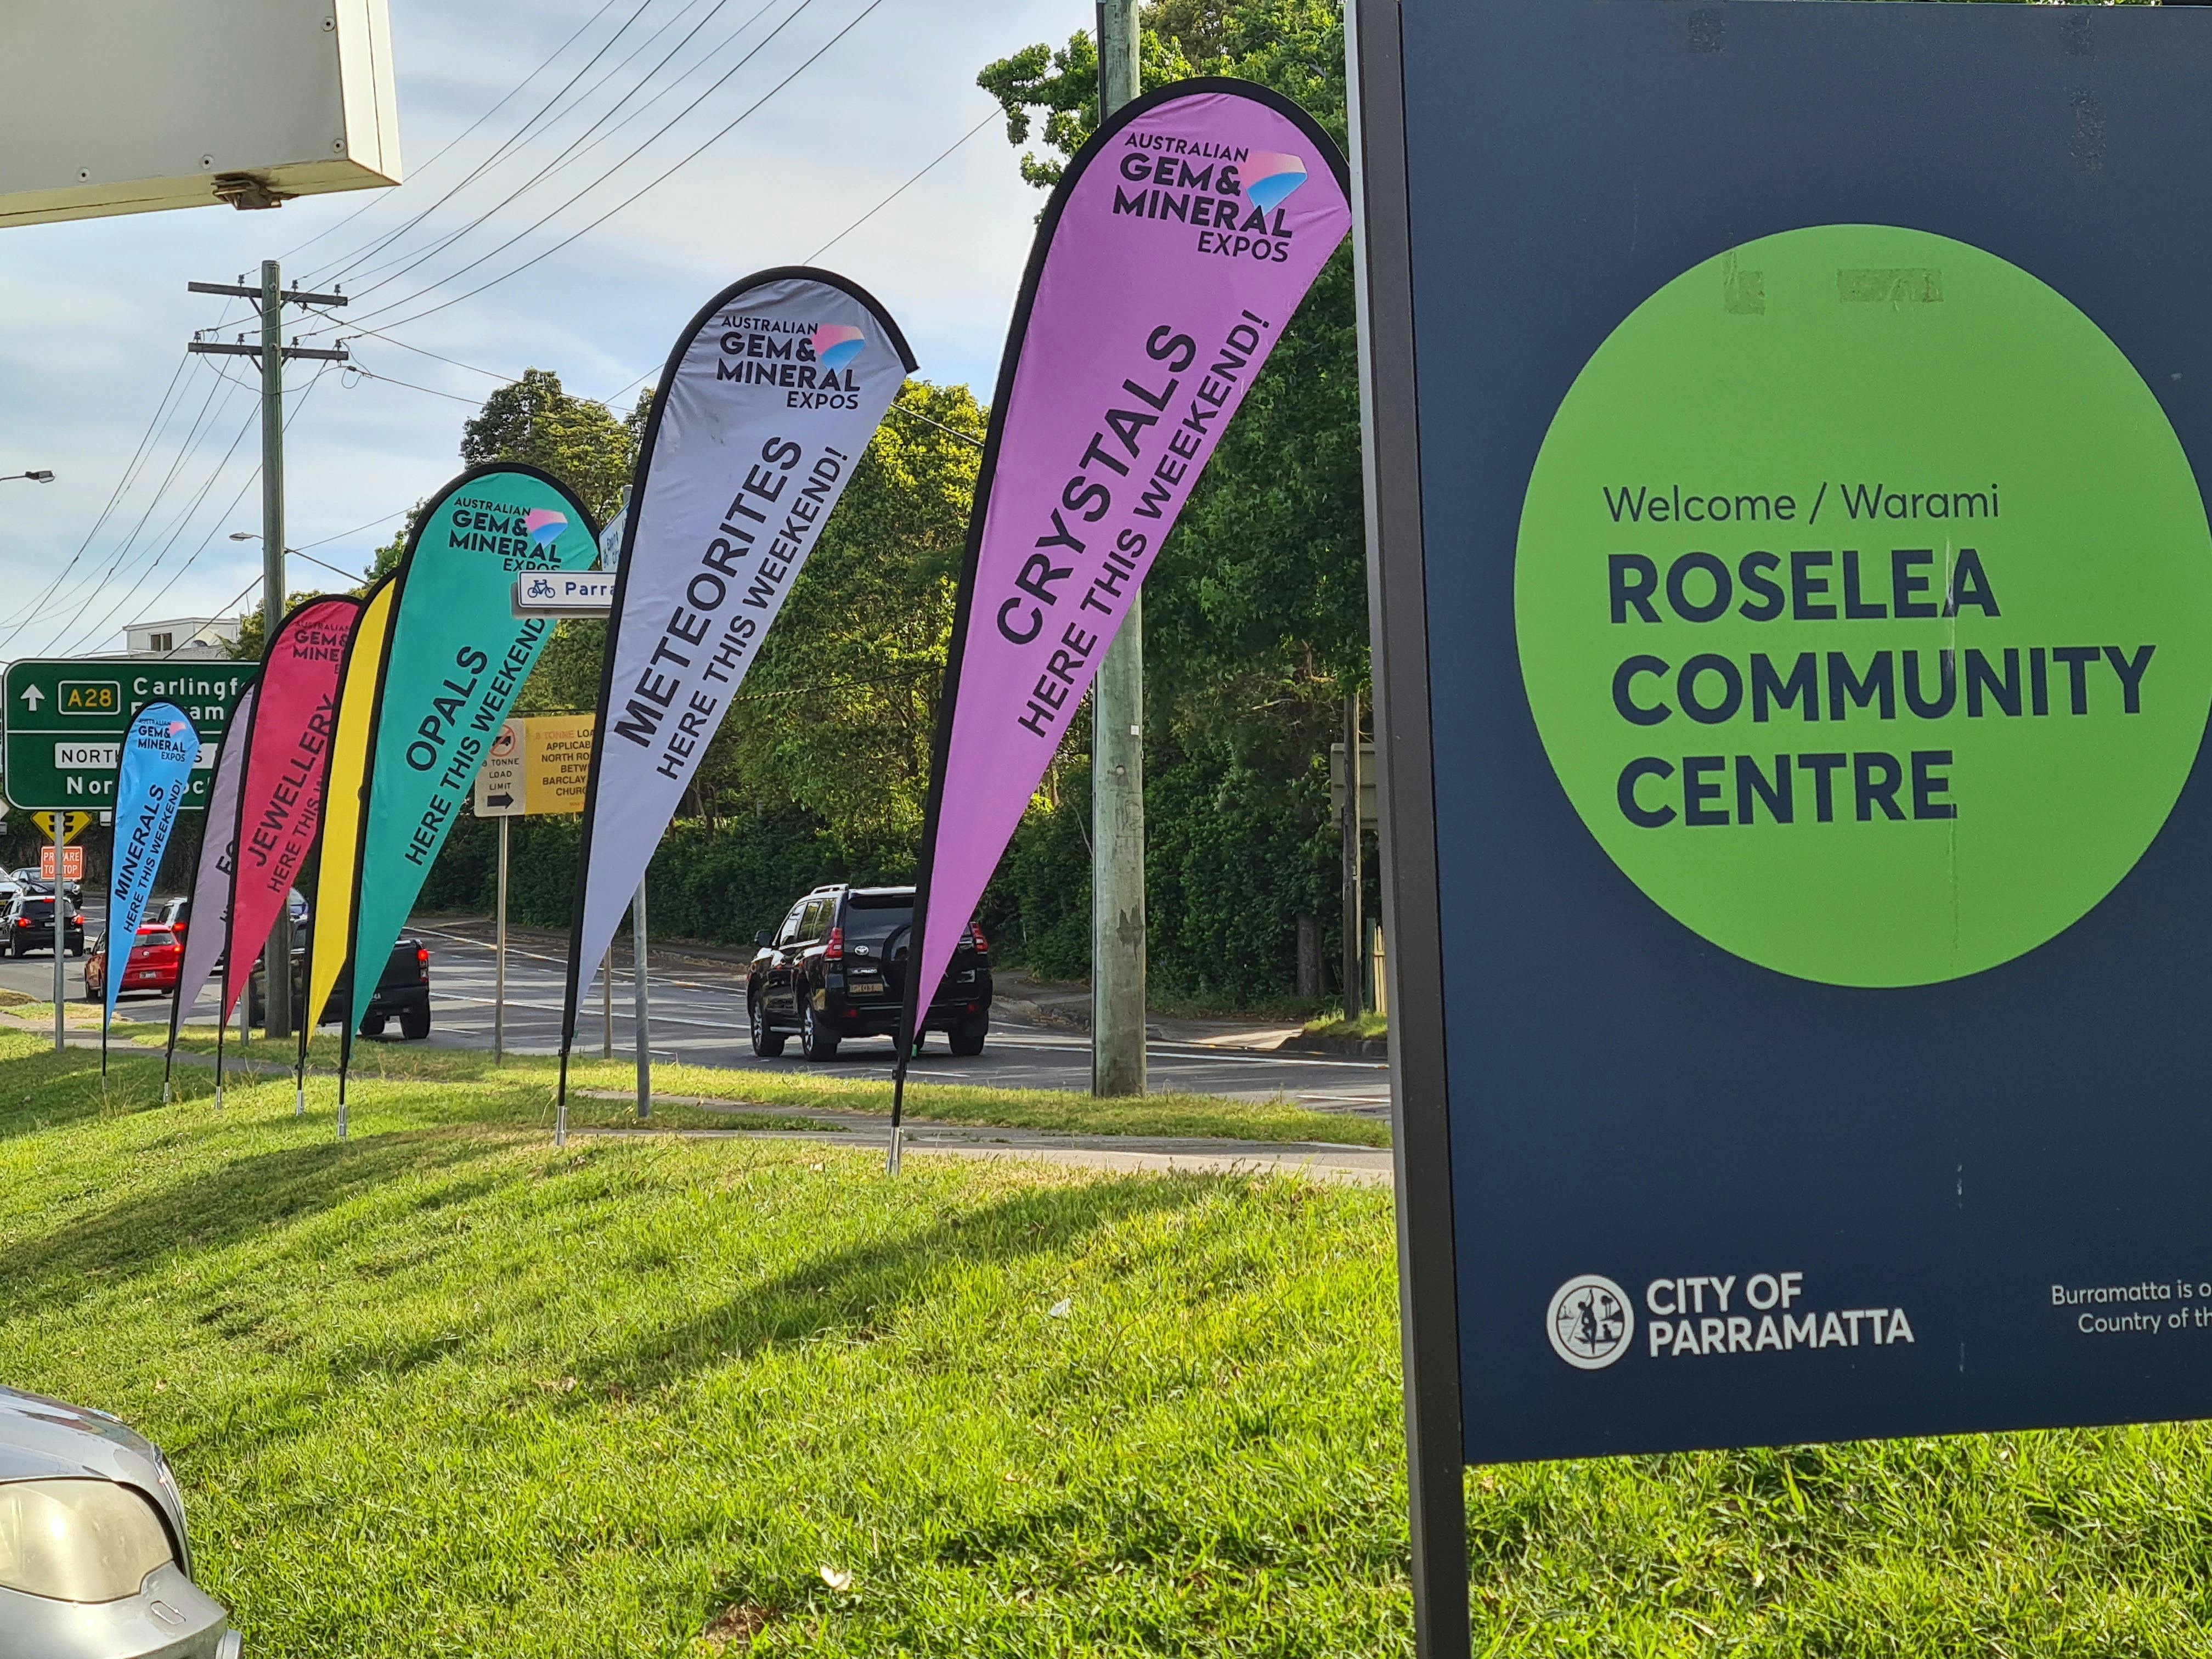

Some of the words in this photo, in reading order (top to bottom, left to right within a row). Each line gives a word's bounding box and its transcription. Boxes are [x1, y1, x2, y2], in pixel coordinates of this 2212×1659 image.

[1125, 133, 1249, 163] AUSTRALIAN
[1113, 184, 1293, 239] MINERAL
[1198, 231, 1289, 263] EXPOS
[721, 315, 818, 335] AUSTRALIAN
[716, 357, 860, 392] MINERAL
[787, 391, 859, 410] EXPOS
[996, 325, 1197, 645] CRYSTALS
[454, 497, 532, 516] AUSTRALIAN
[1603, 485, 1797, 523] Welcome
[1841, 483, 2000, 520] Warami
[1018, 622, 1098, 737] HERE
[1080, 528, 1147, 615] THIS
[1133, 309, 1270, 520] WEEKEND!
[449, 529, 562, 563] MINERAL
[614, 437, 802, 748] METEORITES
[1608, 549, 2001, 624] ROSELEA
[657, 690, 717, 780] HERE
[703, 615, 756, 683] THIS
[742, 446, 848, 609] WEEKEND!
[293, 646, 343, 662] MINE
[67, 689, 112, 708] A28
[133, 677, 246, 701] Carlingf
[1612, 645, 2157, 726] COMMUNITY
[406, 646, 488, 771] OPALS
[138, 738, 186, 753] MINERAL
[543, 730, 574, 739] TONNE
[577, 729, 594, 738] LOA
[546, 741, 591, 751] APPLICAB
[161, 752, 185, 763] EXPOS
[541, 753, 573, 762] NORTH
[561, 765, 588, 773] BETW
[67, 776, 113, 795] Nor
[543, 776, 585, 785] BARCLAY
[1616, 750, 1957, 829] CENTRE
[405, 794, 452, 865] HERE
[440, 736, 481, 789] THIS
[44, 852, 80, 862] PRARE
[115, 784, 163, 901] MINERALS
[123, 894, 144, 933] HERE
[138, 857, 155, 889] THIS
[150, 779, 183, 854] WEEKEND!
[267, 840, 301, 893] HERE
[292, 798, 319, 838] THIS
[44, 865, 54, 874] TO
[63, 865, 77, 874] TOP
[1646, 1276, 1736, 1315] CITY
[1746, 1272, 1803, 1310] OF
[2051, 1282, 2171, 1305] Burramatta
[2176, 1279, 2192, 1299] is
[1649, 1307, 1915, 1357] PARRAMATTA
[2078, 1312, 2161, 1334] Country
[2168, 1307, 2189, 1328] of
